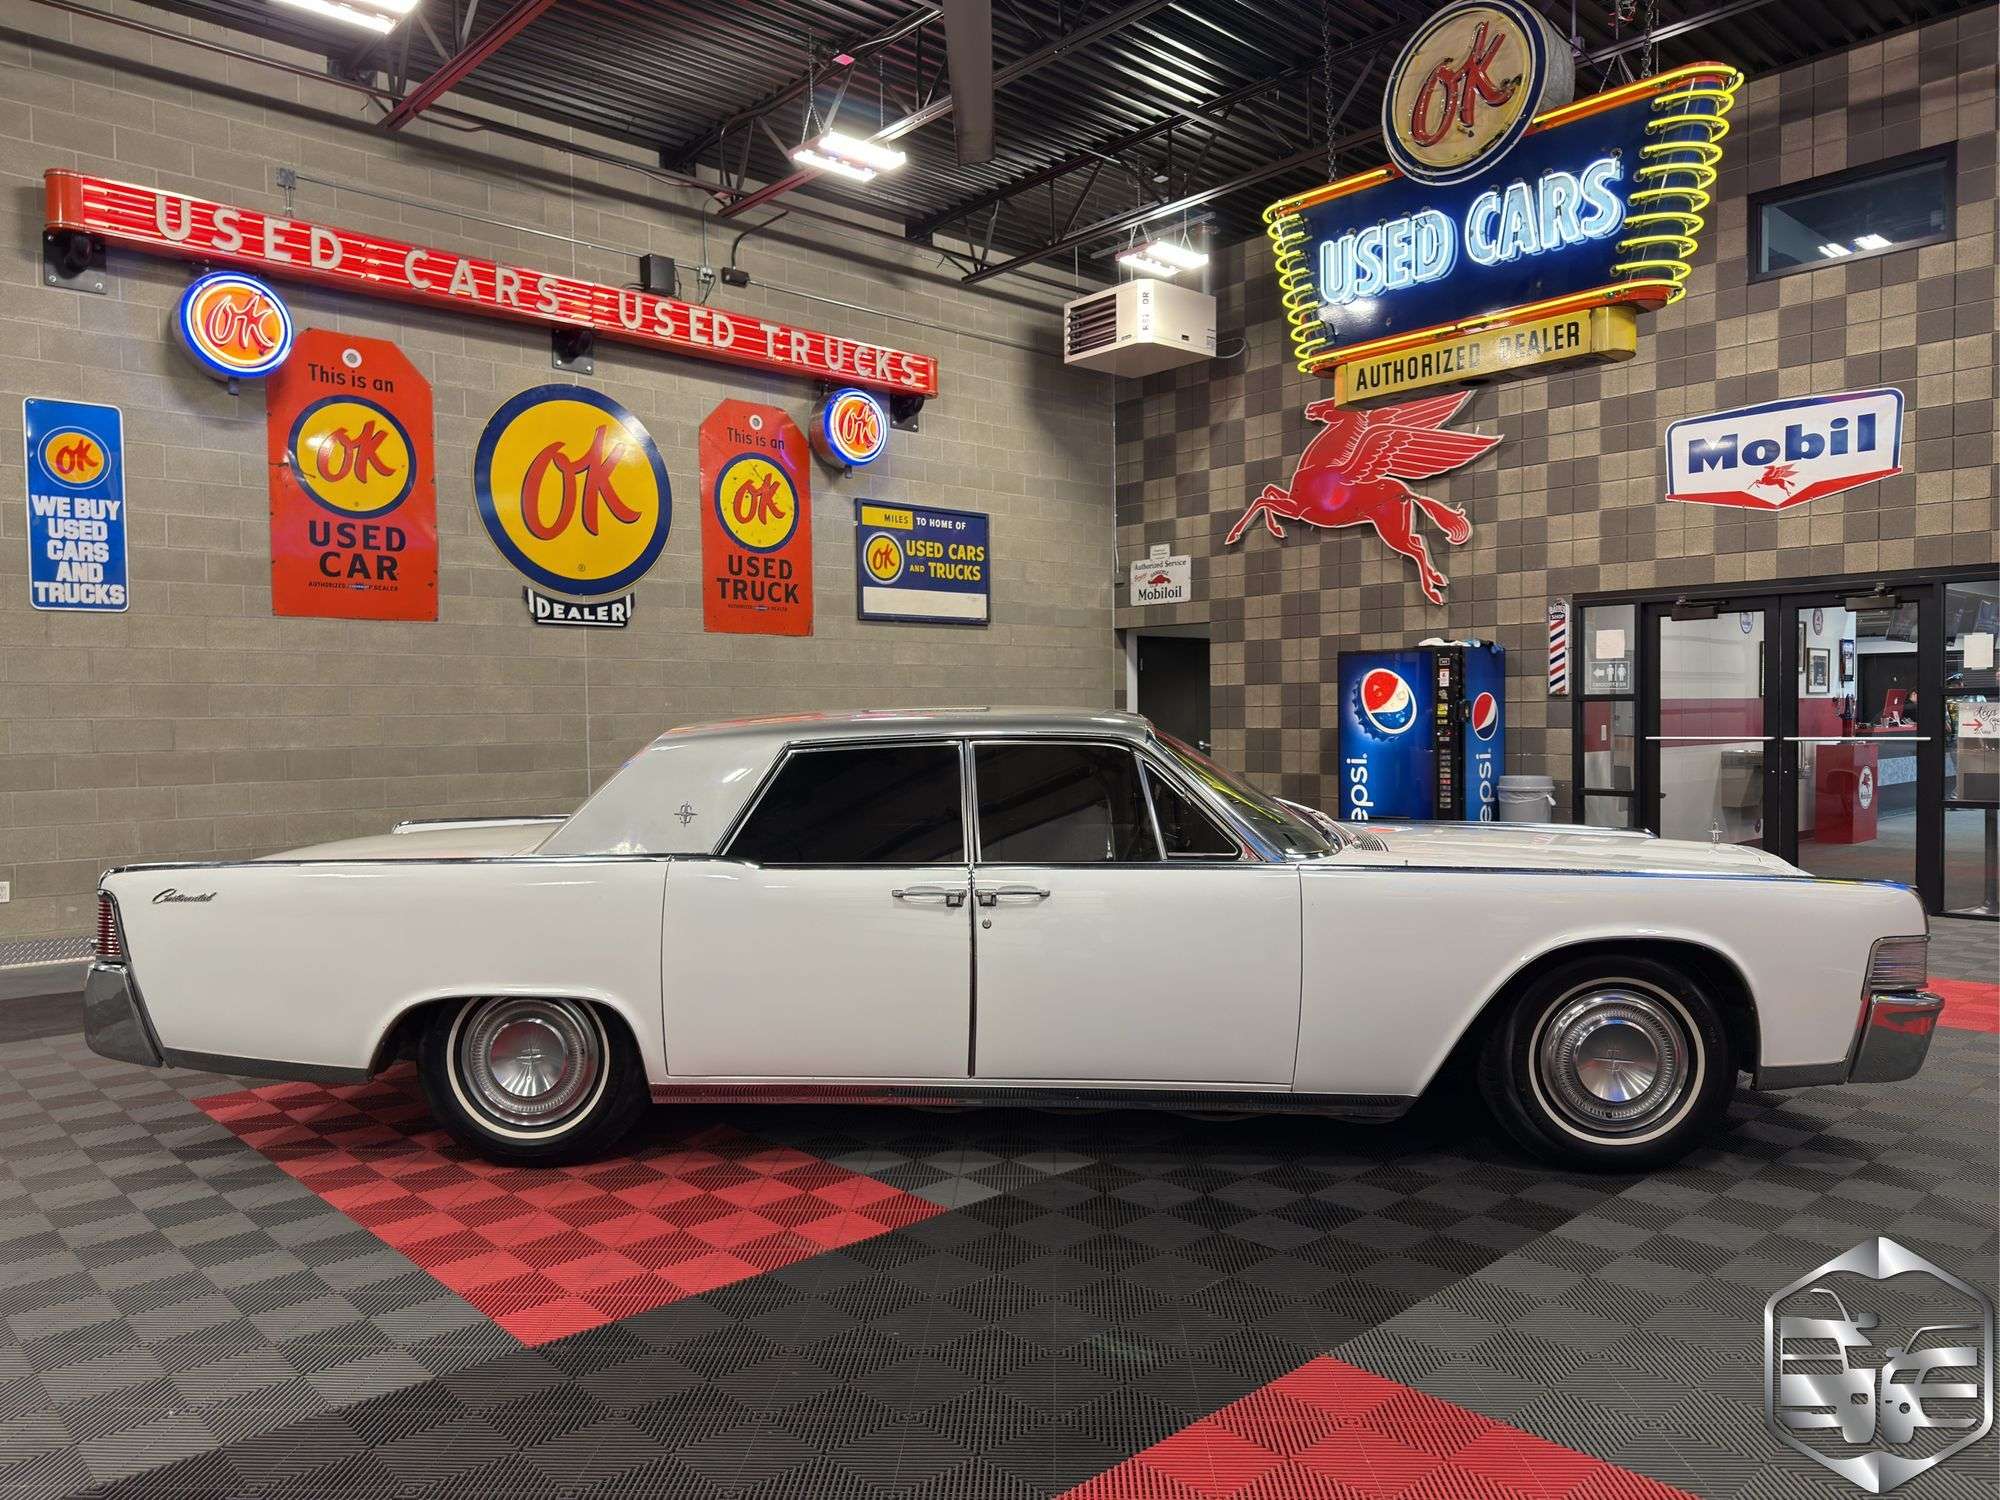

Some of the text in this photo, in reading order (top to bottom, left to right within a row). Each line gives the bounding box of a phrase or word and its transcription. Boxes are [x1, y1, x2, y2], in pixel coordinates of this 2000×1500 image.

[1411, 21, 1517, 147] OK
[1319, 157, 1627, 305] USED CARS
[155, 193, 918, 386] USED CARS USED TRUCKS
[205, 290, 276, 351] OK
[1355, 320, 1581, 392] AUTHORIZED DEALER
[307, 363, 395, 393] This is an
[727, 426, 785, 450] This is an
[840, 402, 880, 448] OK
[56, 438, 98, 474] OK
[316, 419, 397, 484] OK
[1688, 412, 1876, 475] Mobil
[521, 424, 642, 541] OK
[31, 494, 121, 521] WE BUY
[733, 472, 786, 525] OK
[48, 518, 109, 542] USED
[308, 520, 407, 553] USED
[883, 513, 967, 531] MILES TO HOME OF
[47, 539, 110, 563] CARS
[319, 550, 399, 581] CAR
[872, 543, 896, 571] OK
[906, 539, 985, 562] USED CARS
[56, 562, 104, 584] AND
[728, 554, 793, 580] USED
[909, 561, 982, 582] AND TRUCKS
[34, 581, 126, 605] TRUCKS
[717, 577, 800, 604] TRUCK
[1138, 585, 1182, 601] Mobiloil
[536, 596, 626, 623] DEALER
[1346, 758, 1374, 824] epsi
[1476, 752, 1495, 821] epsi
